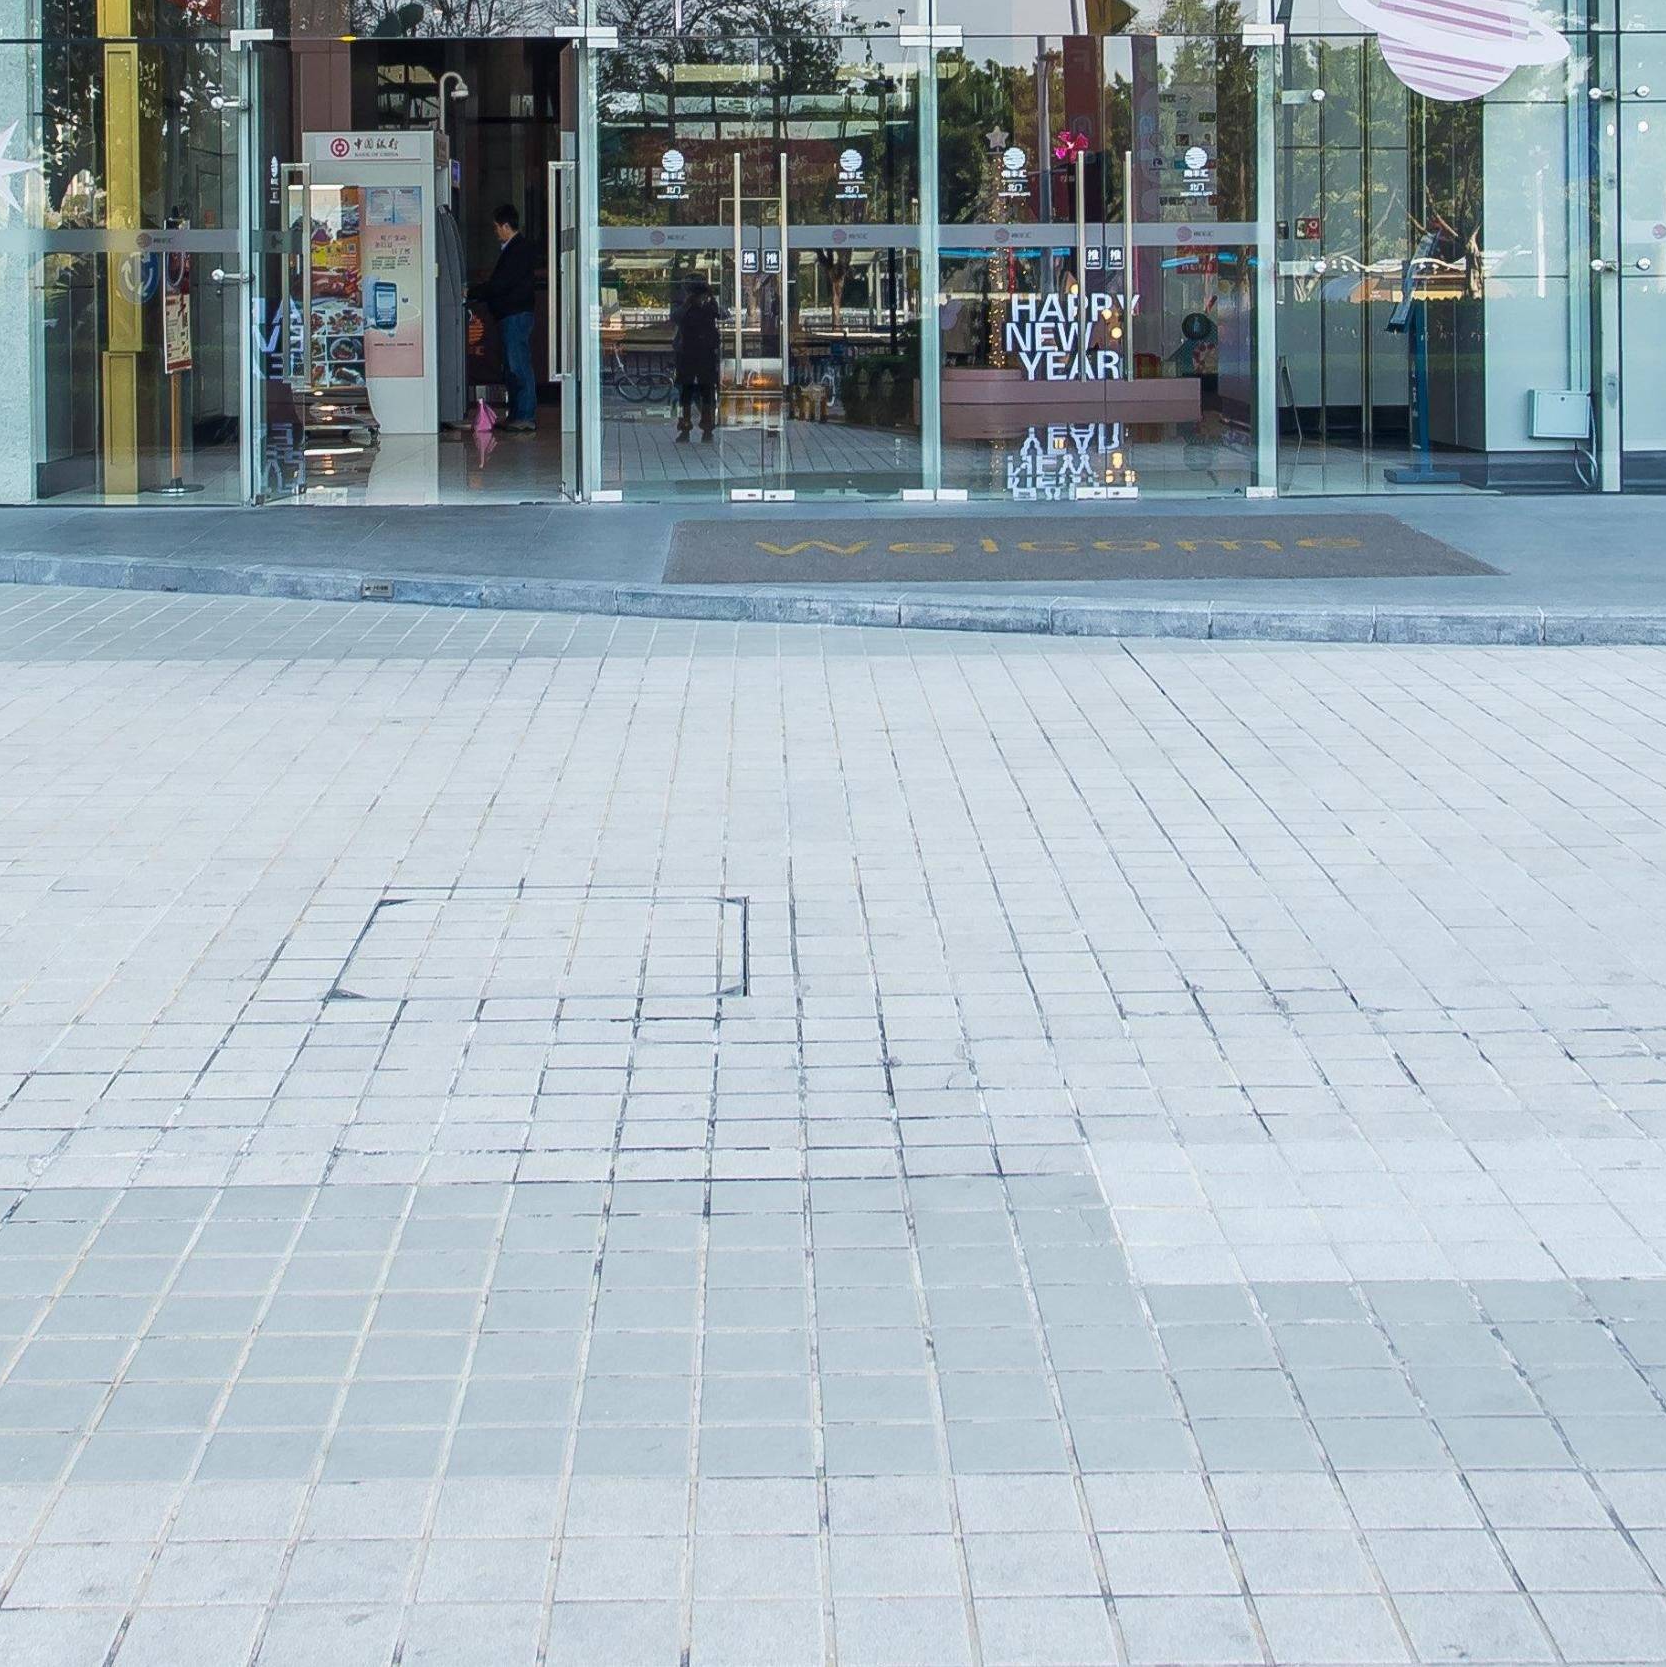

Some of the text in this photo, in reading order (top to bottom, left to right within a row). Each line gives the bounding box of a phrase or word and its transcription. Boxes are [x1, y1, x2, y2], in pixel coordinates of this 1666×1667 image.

[1011, 293, 1141, 322] HAPPY
[1006, 322, 1093, 351] NEW
[1019, 350, 1121, 380] YEAR
